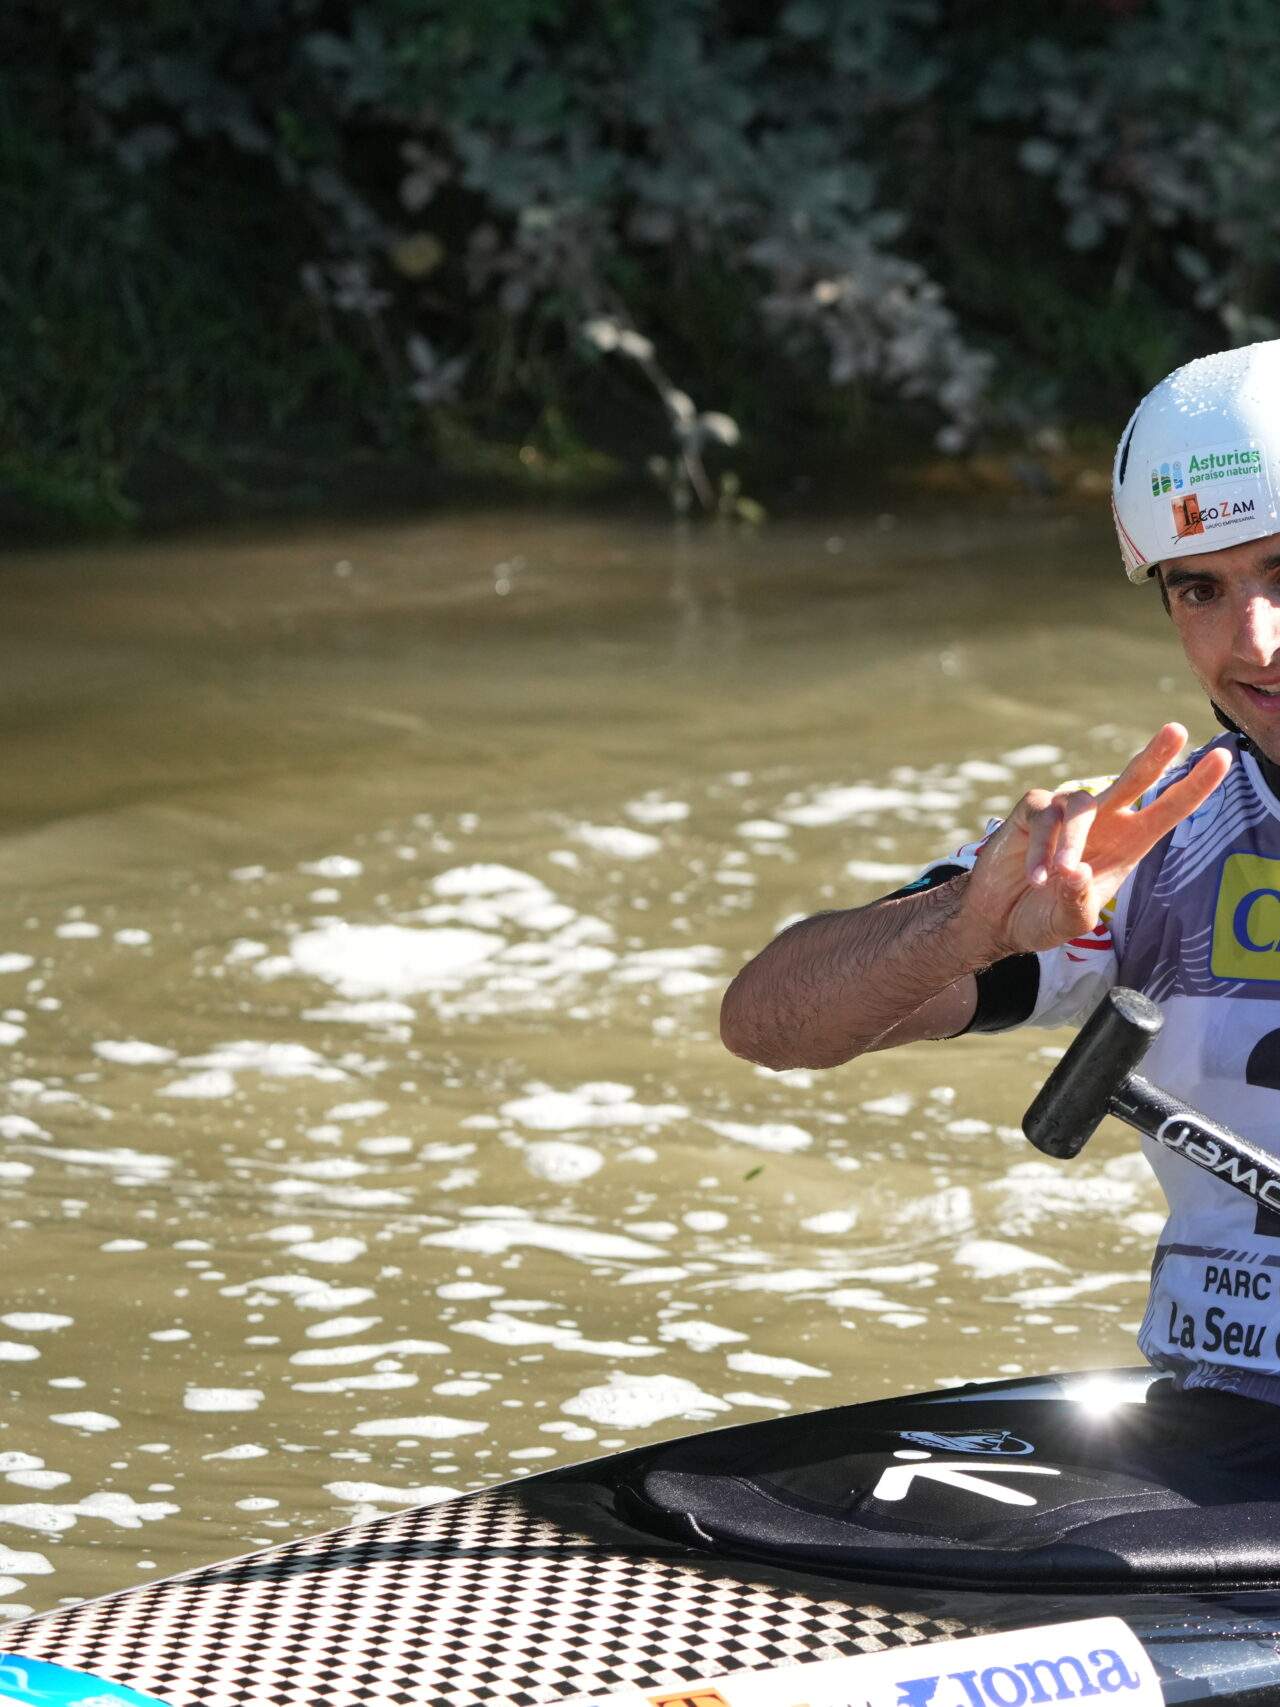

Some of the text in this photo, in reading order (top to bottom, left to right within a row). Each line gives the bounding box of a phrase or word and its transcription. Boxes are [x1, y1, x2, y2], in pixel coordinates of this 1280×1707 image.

[1188, 450, 1261, 473] Asturias
[1226, 463, 1262, 477] natural
[1203, 1265, 1271, 1301] PARC
[1168, 1301, 1195, 1350] La
[1202, 1306, 1267, 1358] Seu
